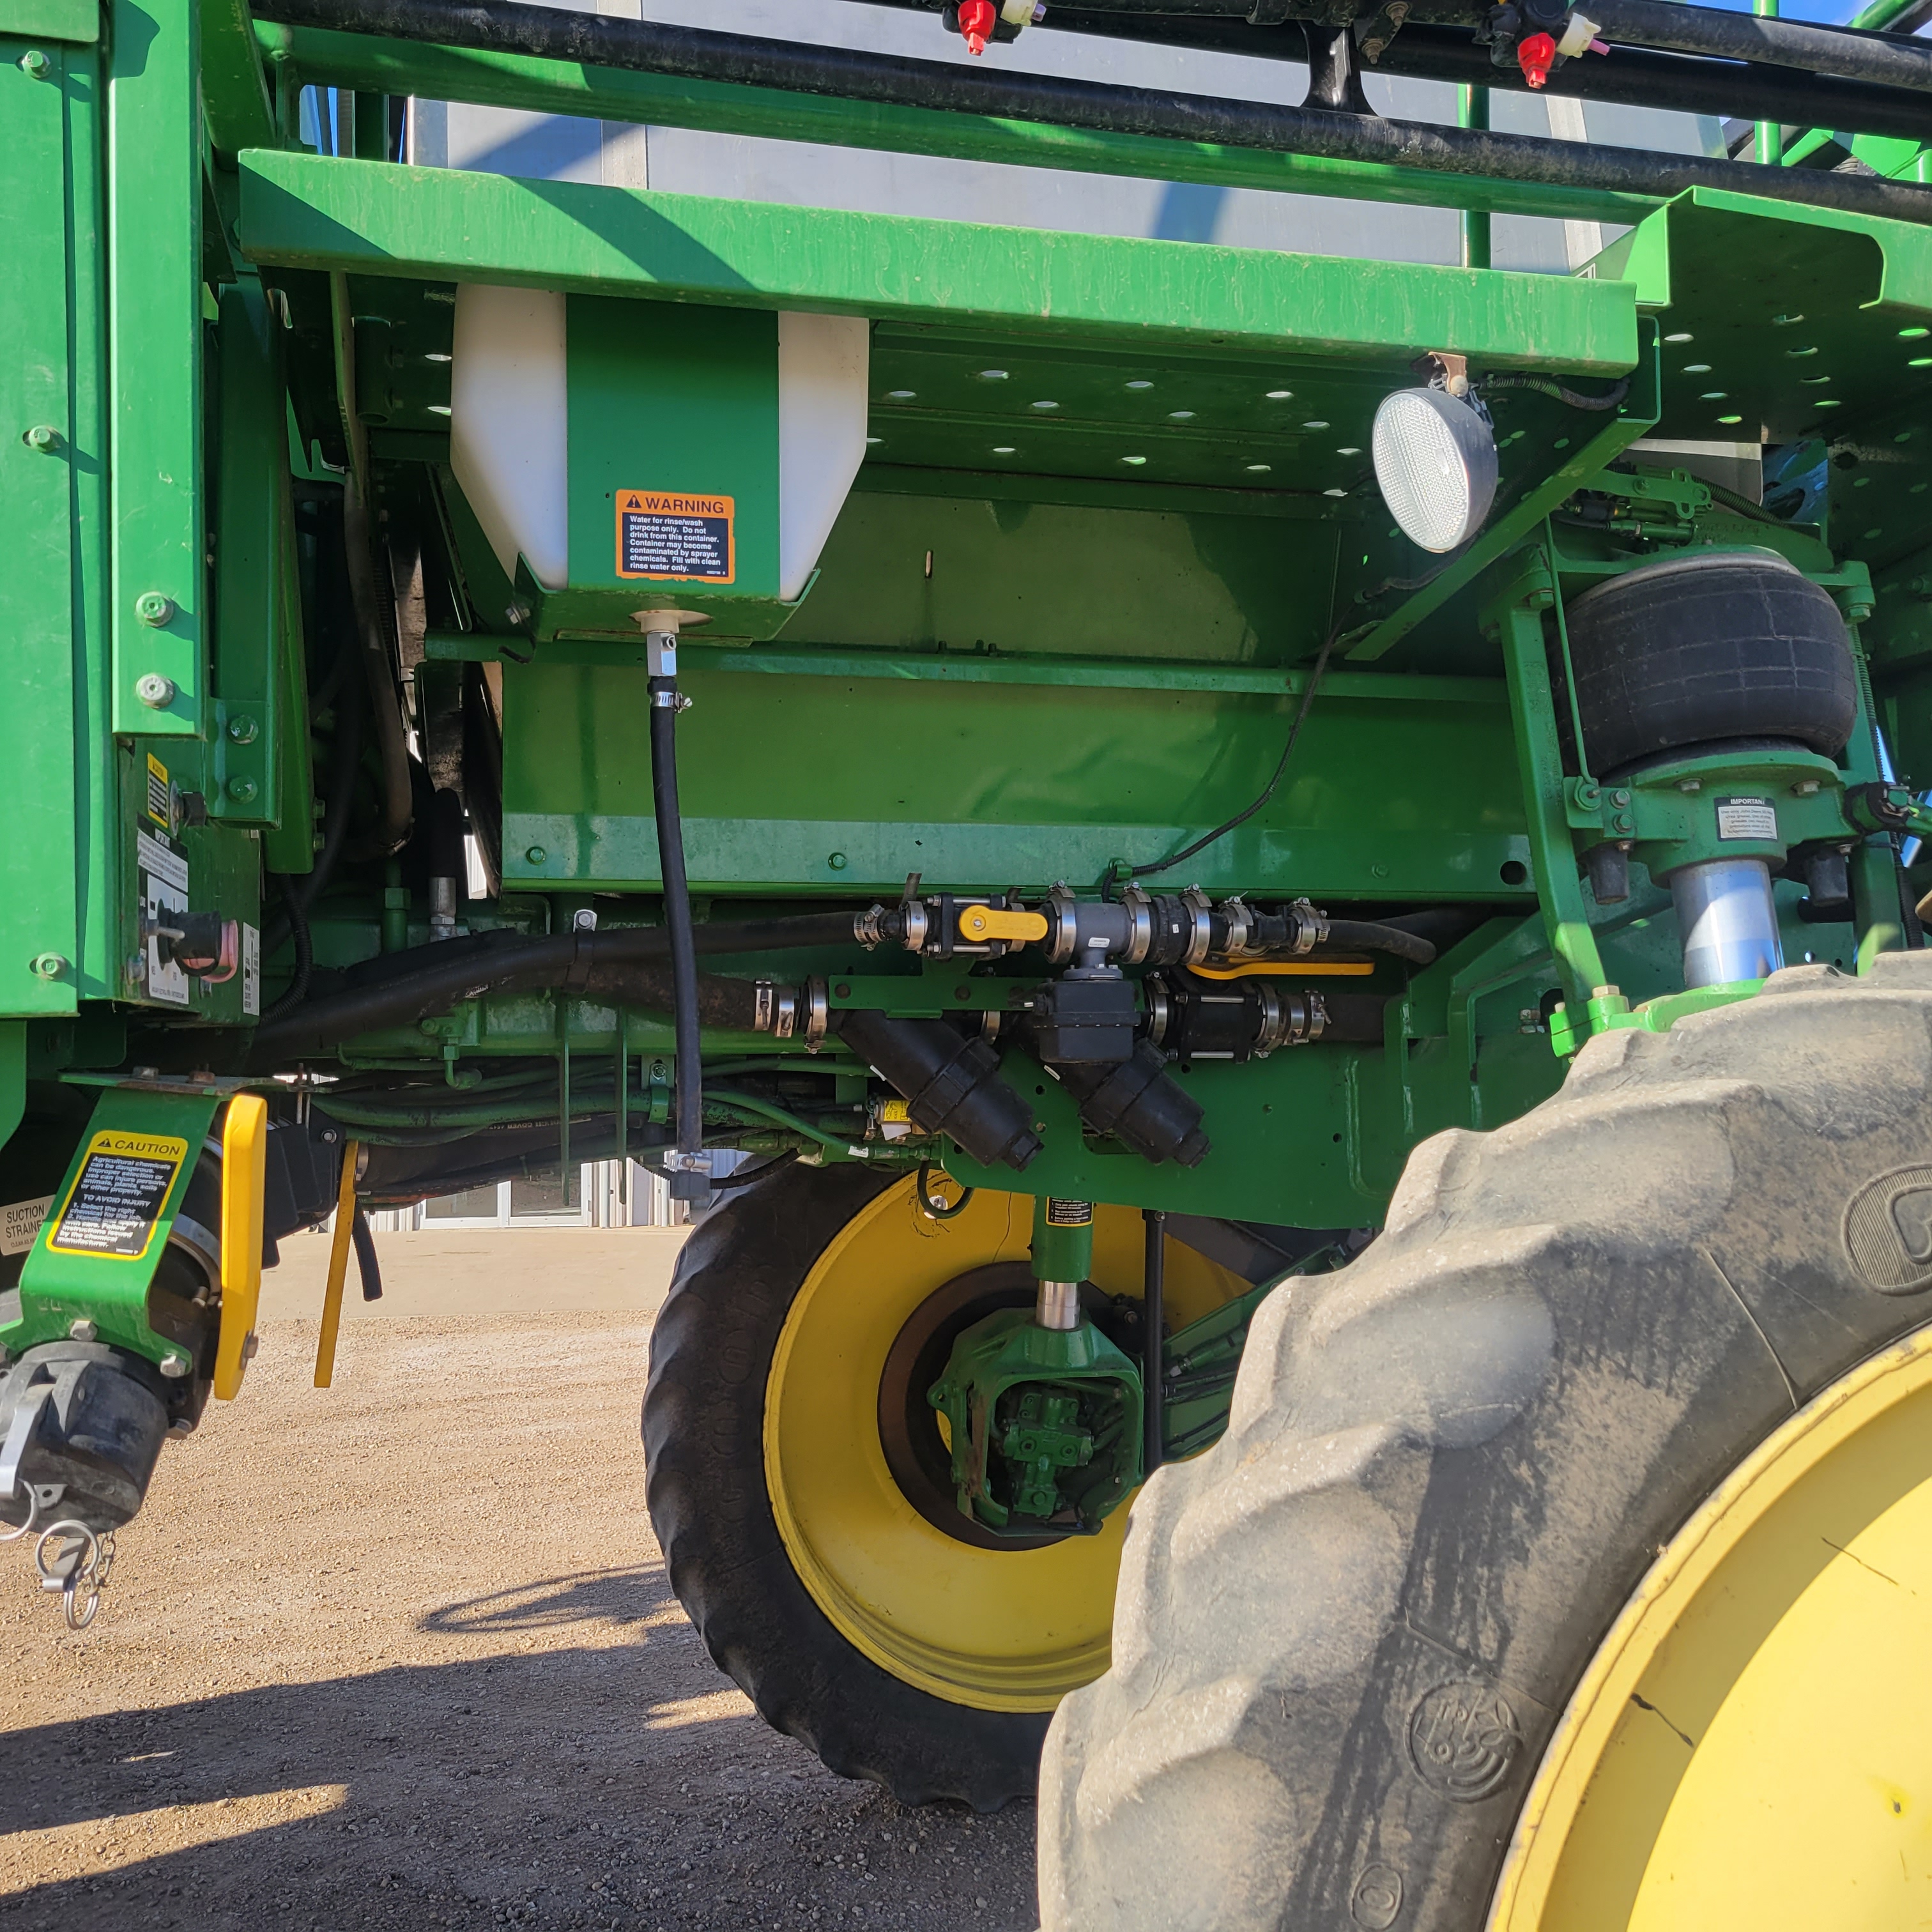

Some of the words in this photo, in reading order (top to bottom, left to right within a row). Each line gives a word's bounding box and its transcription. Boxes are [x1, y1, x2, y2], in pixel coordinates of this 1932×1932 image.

[645, 496, 724, 514] WARNING
[664, 518, 703, 526] rinse/wash
[629, 539, 665, 547] Container
[629, 555, 668, 563] chemicals.
[671, 565, 689, 573] only.
[114, 1140, 181, 1156] CAUTION
[93, 1156, 135, 1166] Agricultural
[135, 1161, 172, 1170] chemicals
[88, 1166, 121, 1176] Improper
[121, 1171, 154, 1179] selection
[115, 1165, 155, 1174] dangerous.
[114, 1175, 136, 1186] injure
[109, 1187, 144, 1197] property.
[95, 1195, 121, 1204] AVOID
[121, 1198, 151, 1208] INJURY
[7, 1203, 45, 1223] SUCTION
[70, 1208, 103, 1217] chemical
[80, 1202, 104, 1211] Select
[118, 1207, 136, 1215] right
[5, 1219, 45, 1239] STRAINE
